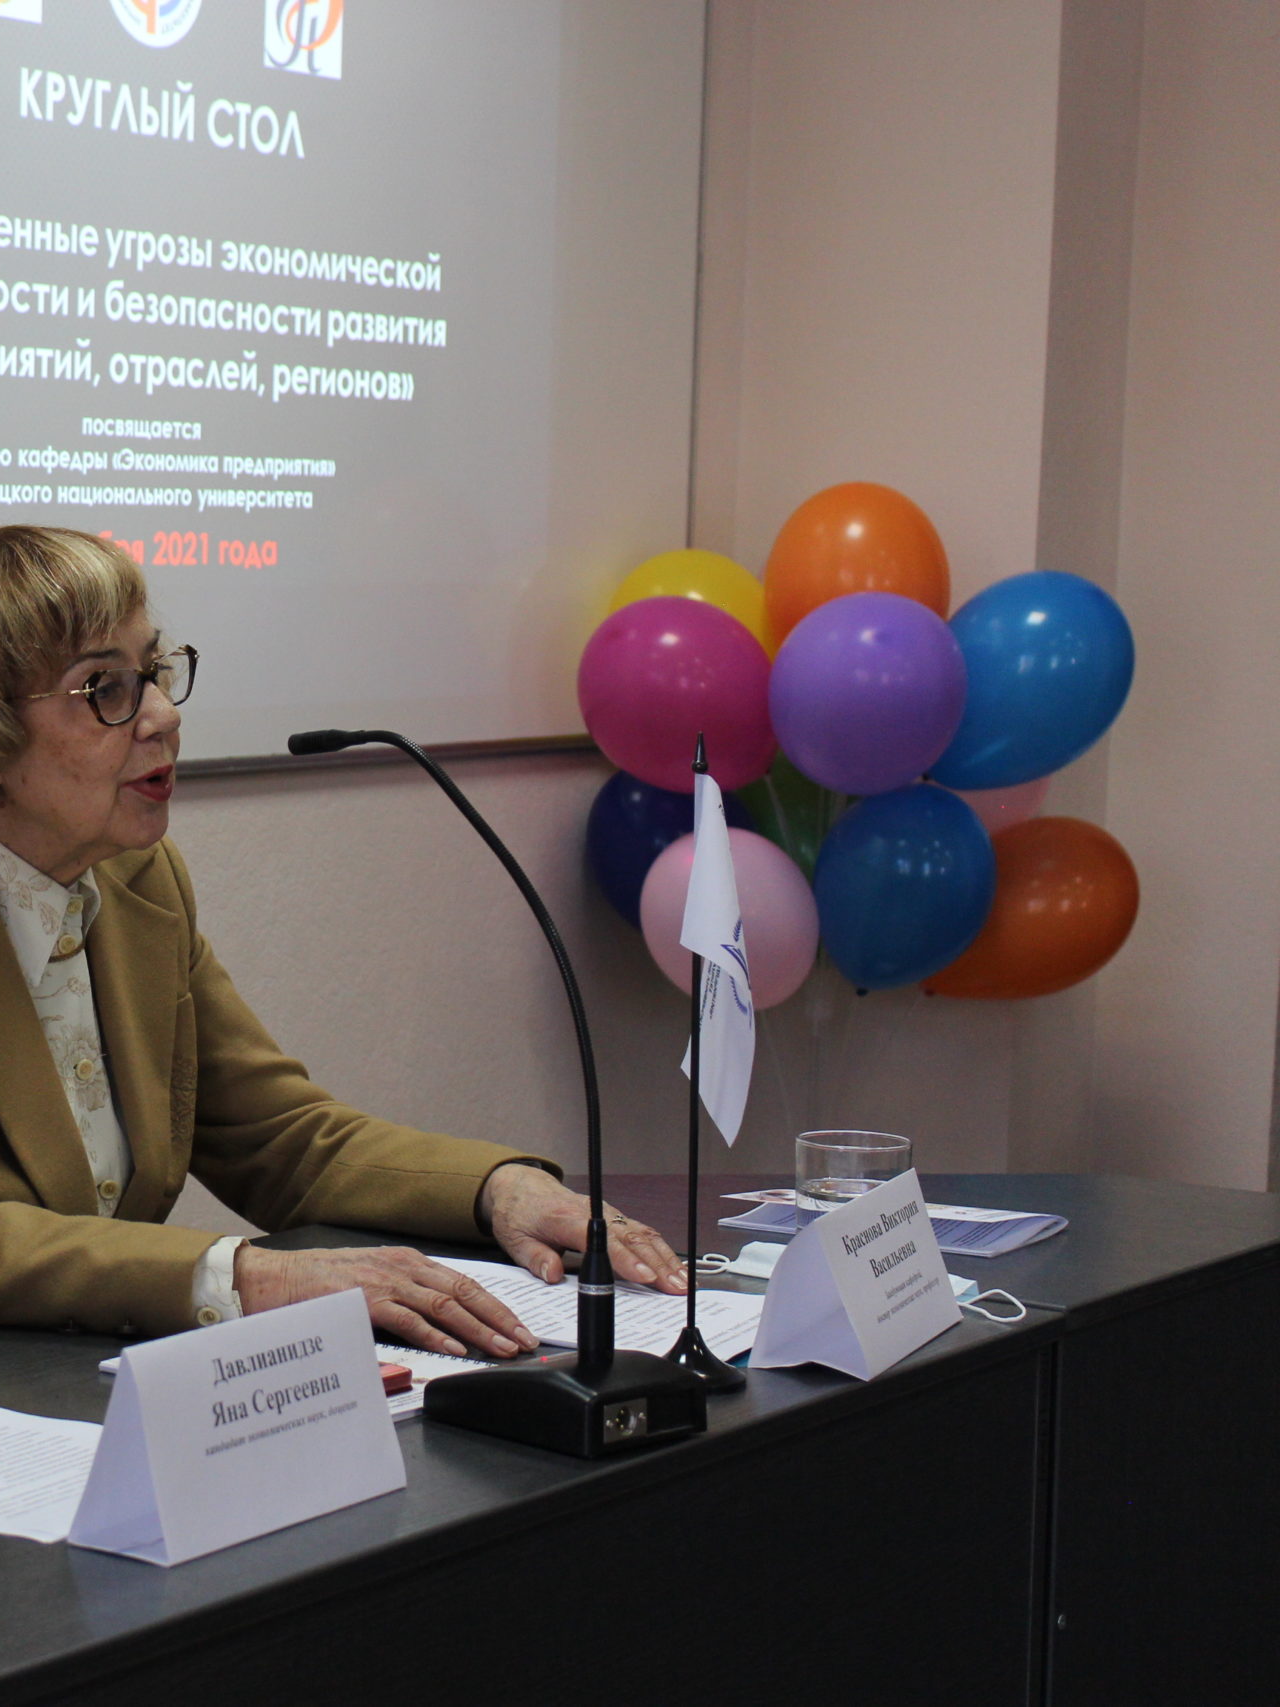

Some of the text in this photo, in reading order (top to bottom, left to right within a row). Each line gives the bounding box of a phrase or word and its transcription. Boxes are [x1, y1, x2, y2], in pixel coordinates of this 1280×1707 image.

[19, 66, 305, 159] КРУГЛЫЙ СТОЛ
[105, 227, 213, 272] угрозы
[220, 240, 442, 293] экономической
[77, 287, 96, 319] и
[104, 279, 322, 338] безопасности
[326, 309, 448, 348] развития
[108, 349, 266, 397] отраслей,
[272, 363, 416, 403] регионов»
[81, 416, 203, 441] посвящается
[17, 444, 108, 476] кафедры
[111, 447, 219, 474] «Экономика
[222, 455, 337, 481] предприятия»
[56, 484, 193, 507] национального
[196, 488, 314, 514] университета
[152, 530, 210, 567] 2021
[218, 539, 279, 570] года
[841, 1200, 920, 1257] Краснова Виктория
[870, 1240, 917, 1278] Васильевна
[212, 1336, 323, 1386] Давлианидзе
[211, 1371, 341, 1428] Яна Сергеевна
